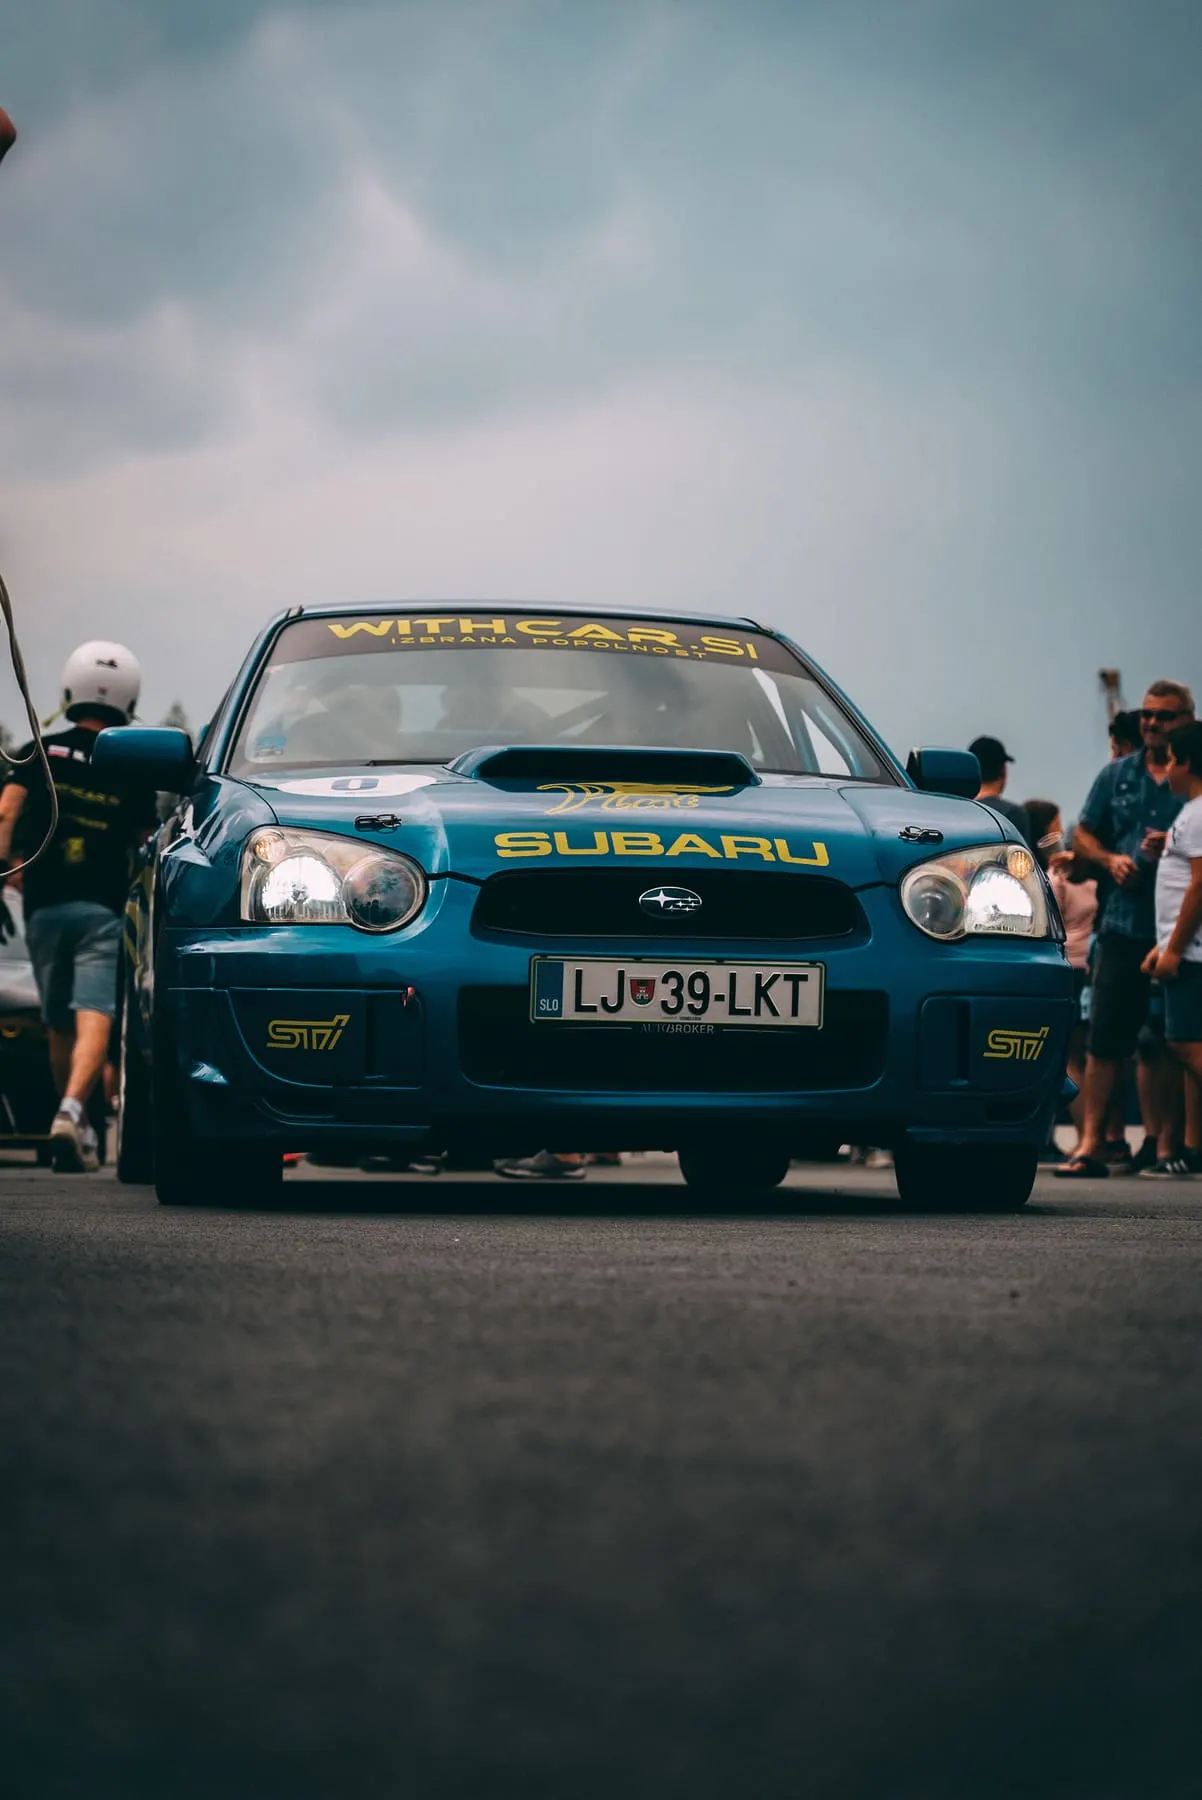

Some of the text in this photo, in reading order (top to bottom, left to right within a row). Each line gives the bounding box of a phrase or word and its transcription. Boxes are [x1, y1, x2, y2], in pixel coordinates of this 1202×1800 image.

[327, 617, 759, 660] WITHCAR.SI
[391, 635, 707, 659] IZBRANA POPOLNOST
[494, 831, 830, 868] SUBARU
[539, 998, 559, 1012] SLO
[574, 968, 809, 1018] LJ 39-LKT
